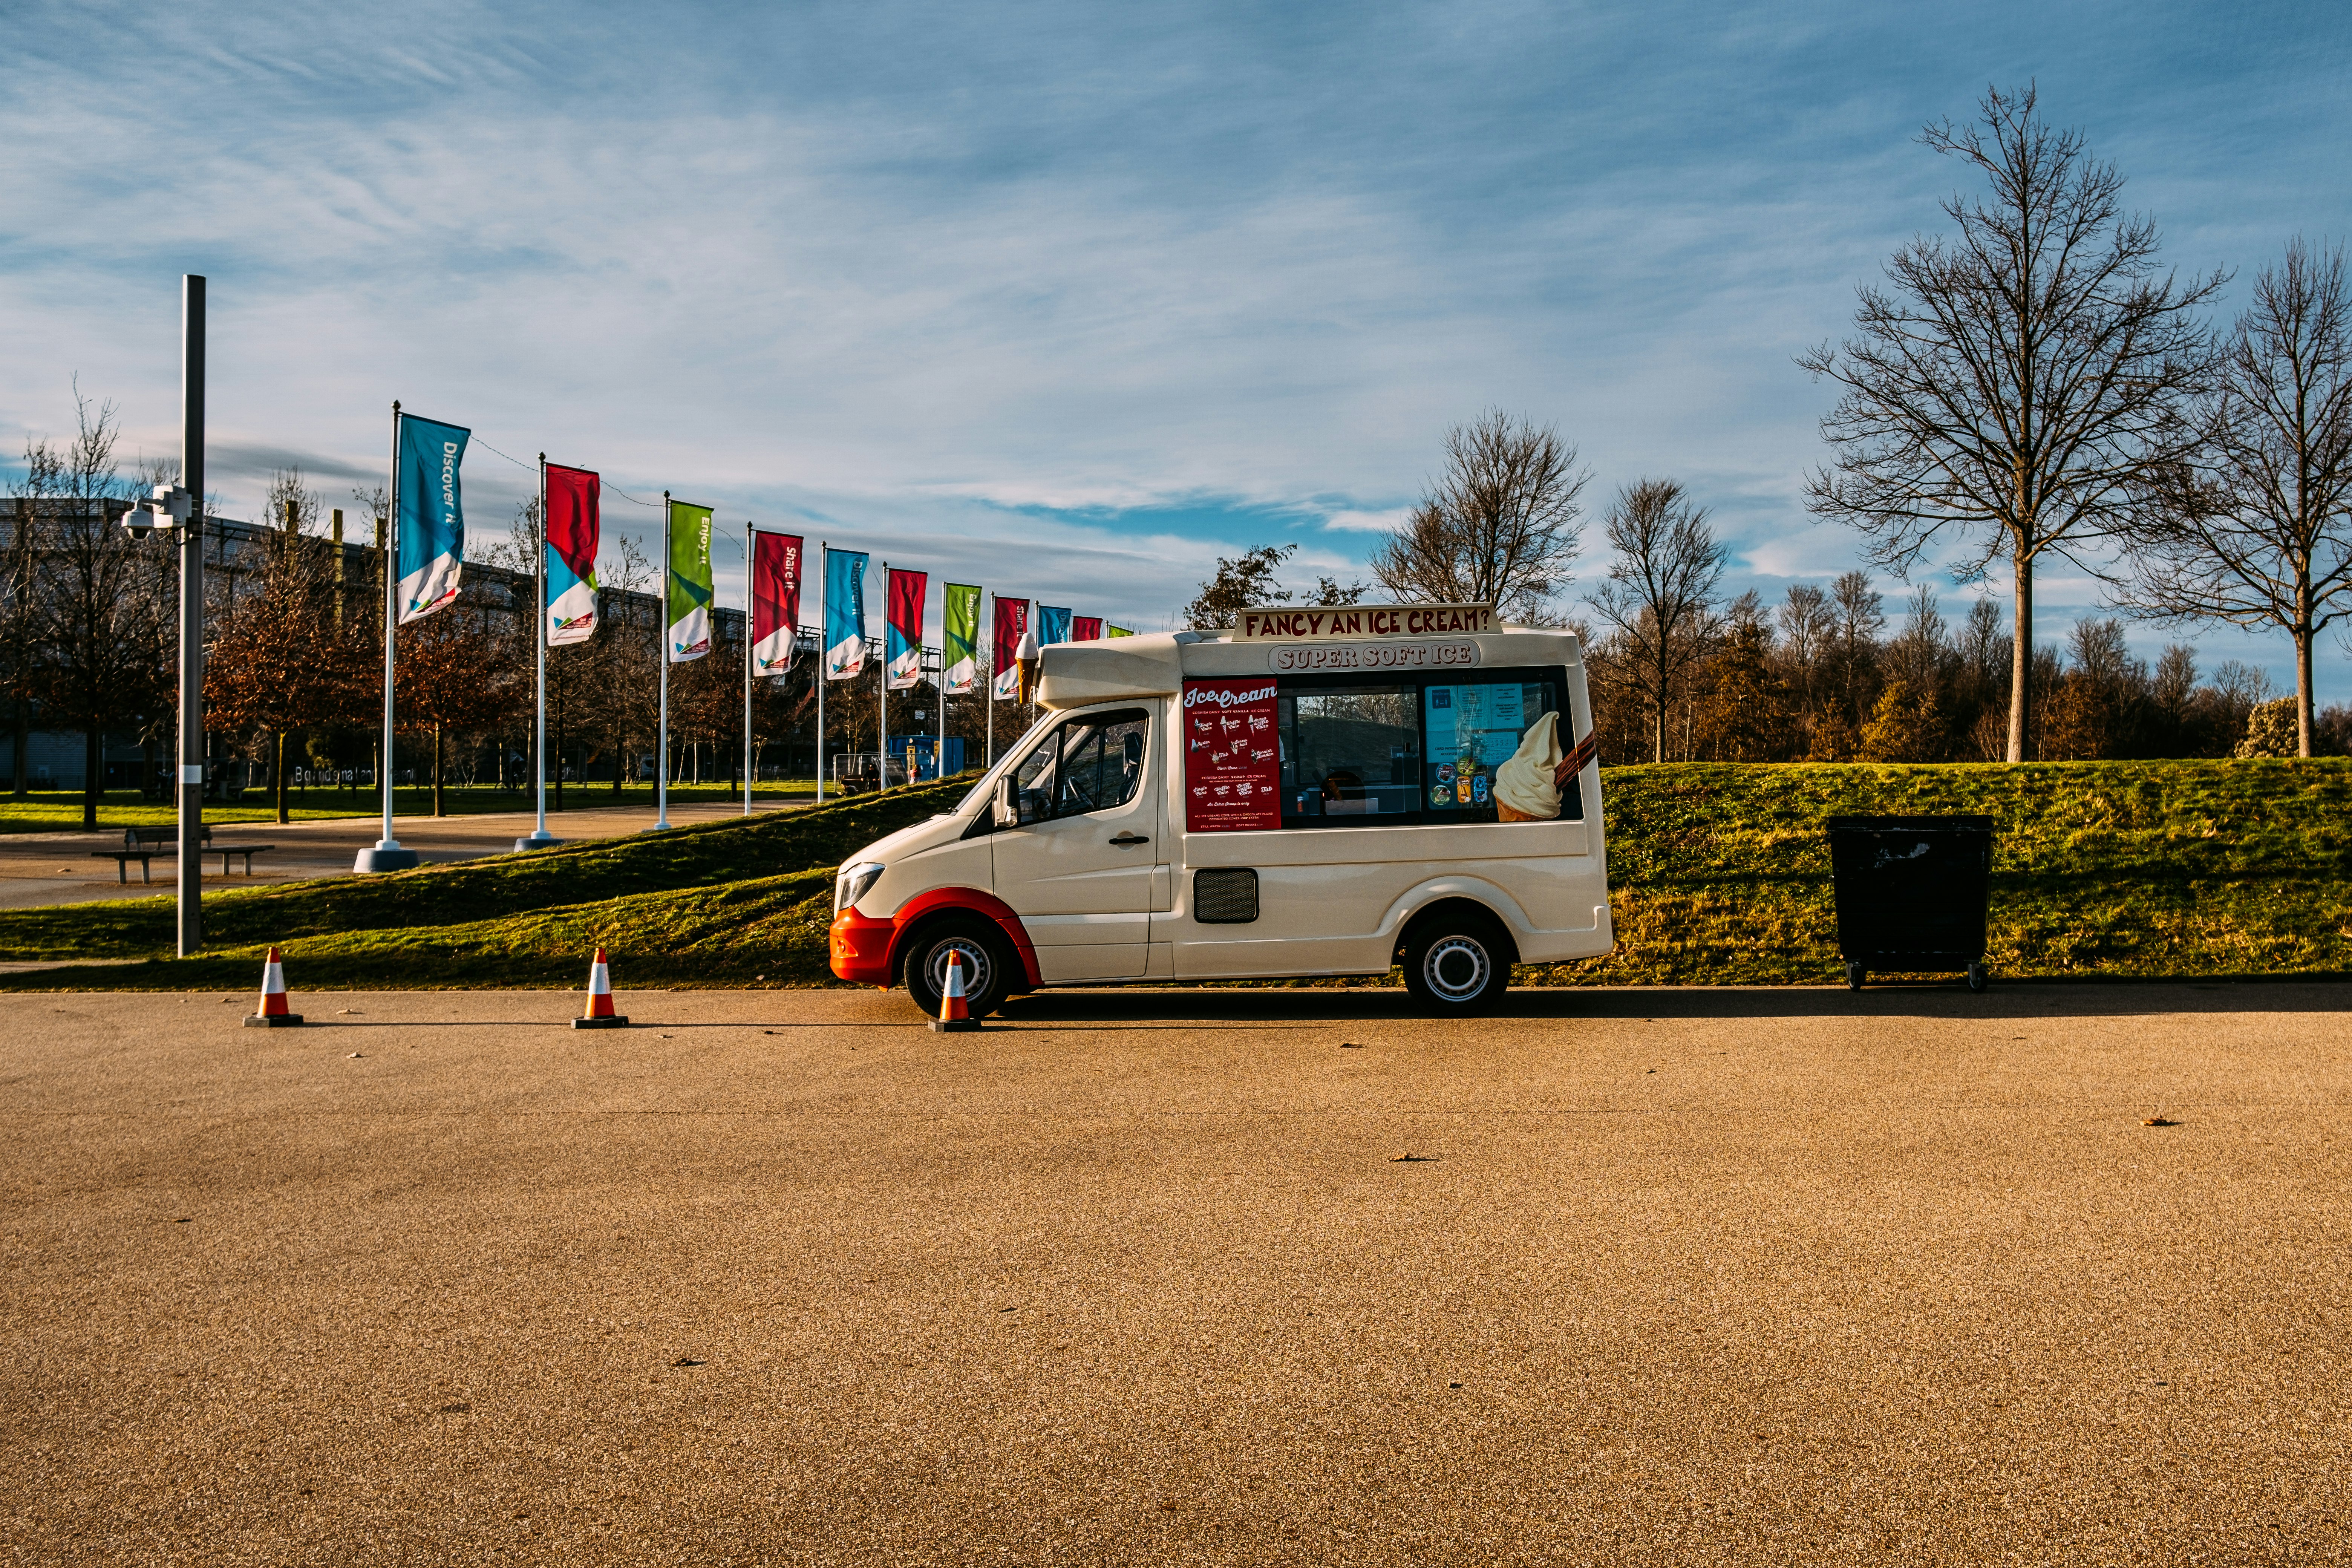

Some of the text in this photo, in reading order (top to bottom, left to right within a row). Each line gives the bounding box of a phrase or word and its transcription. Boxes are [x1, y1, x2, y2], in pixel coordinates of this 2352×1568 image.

[442, 442, 458, 509] Discover
[698, 516, 710, 552] Enjoy
[784, 546, 796, 590] Share it
[851, 561, 863, 605] Discover
[967, 594, 977, 618] Enjoy
[1245, 608, 1490, 637] FANCY AN ICE CREAM?
[1277, 644, 1472, 669] SUPER SOFT ICE
[1184, 686, 1277, 708] Ice Cream
[296, 766, 311, 783] Bg
